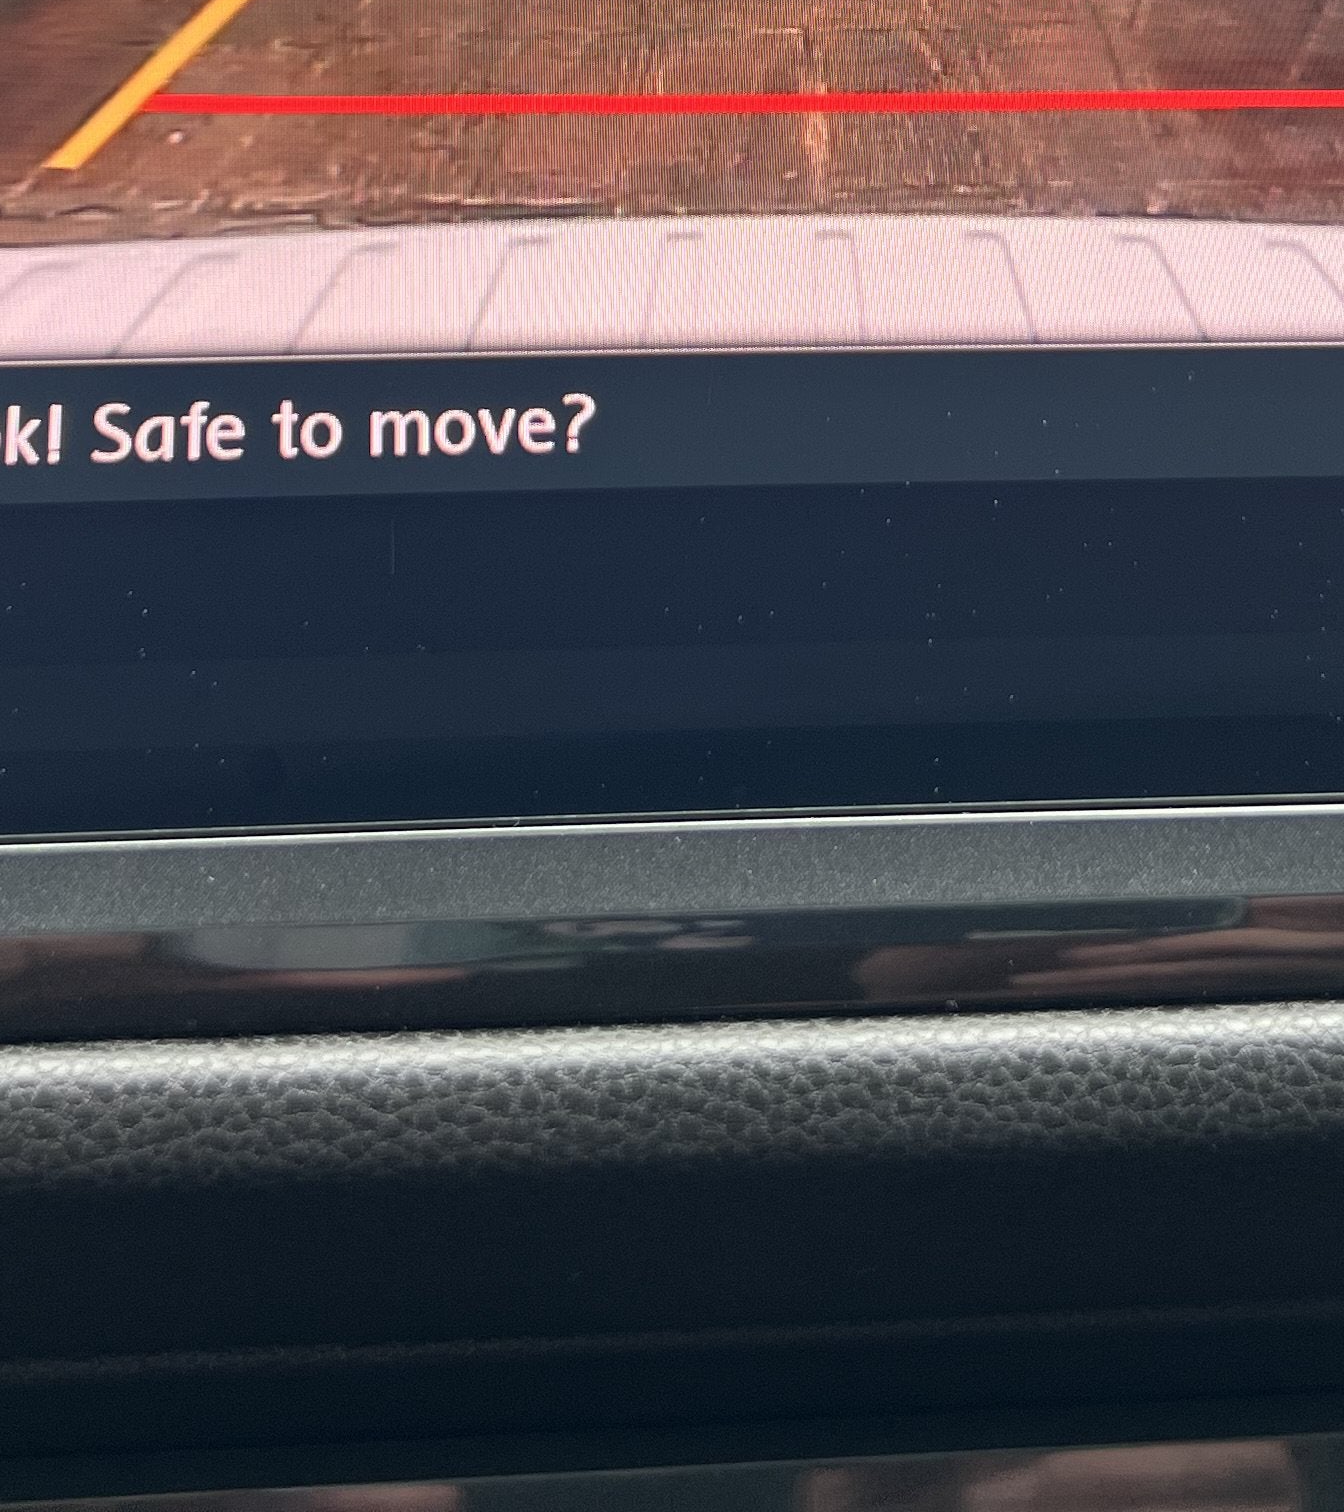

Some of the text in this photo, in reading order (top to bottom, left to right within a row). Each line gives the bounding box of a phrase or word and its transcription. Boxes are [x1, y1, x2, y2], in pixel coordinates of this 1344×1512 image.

[89, 401, 247, 464] Safe
[270, 399, 344, 459] to
[368, 392, 597, 457] move?
